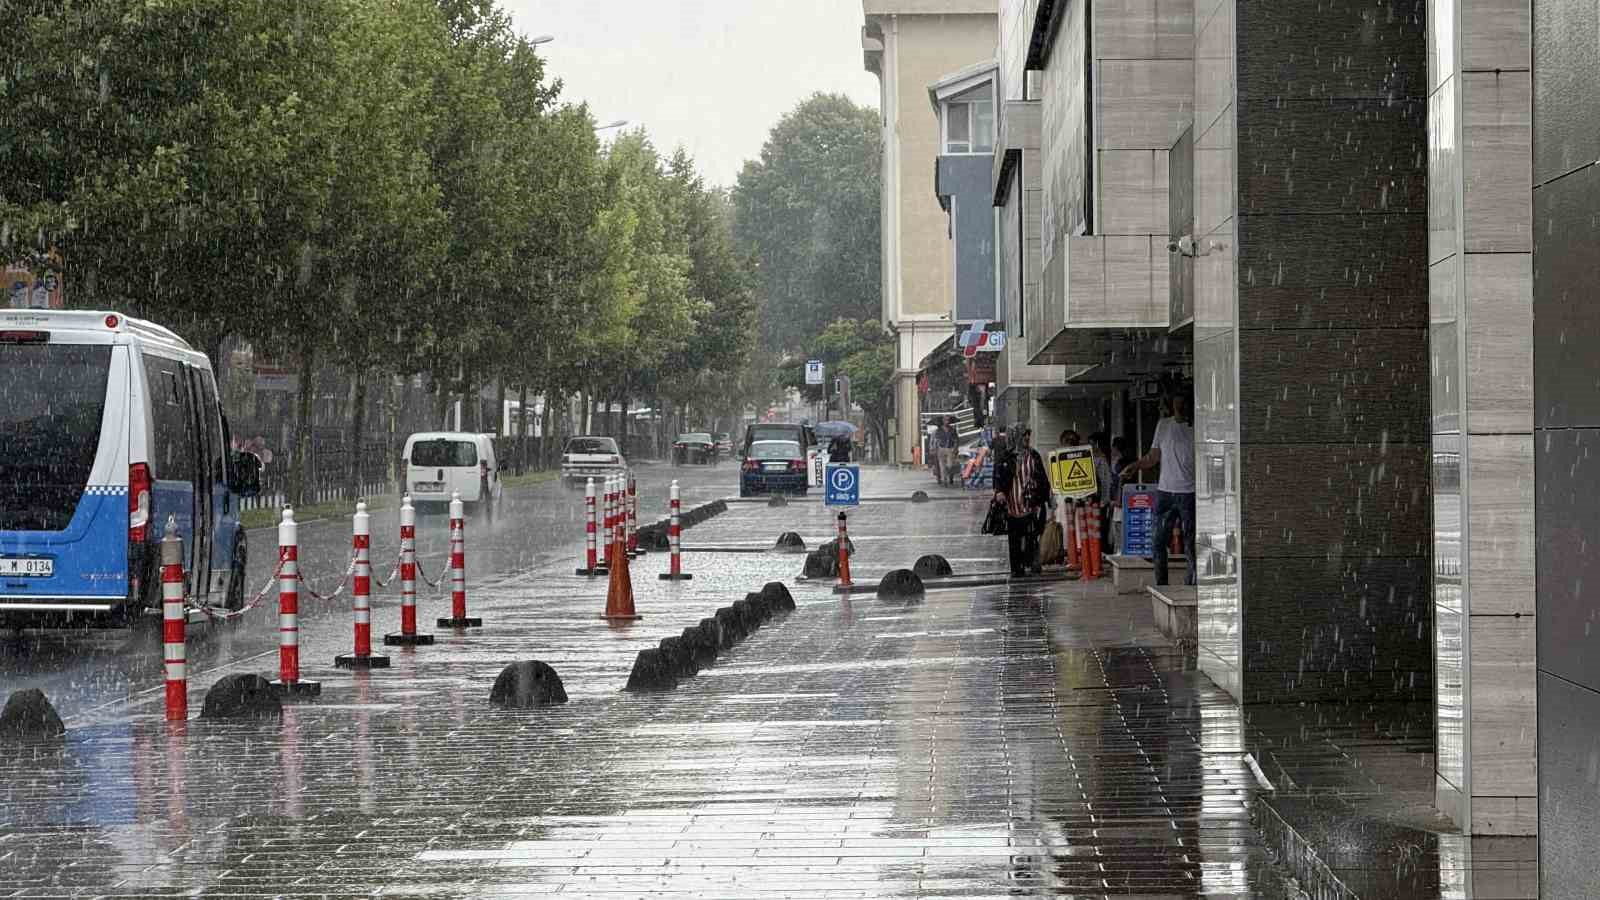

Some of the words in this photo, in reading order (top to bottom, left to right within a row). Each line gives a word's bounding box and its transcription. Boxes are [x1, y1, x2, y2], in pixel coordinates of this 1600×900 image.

[838, 472, 849, 487] P
[11, 561, 18, 571] M
[26, 560, 51, 572] 0134
